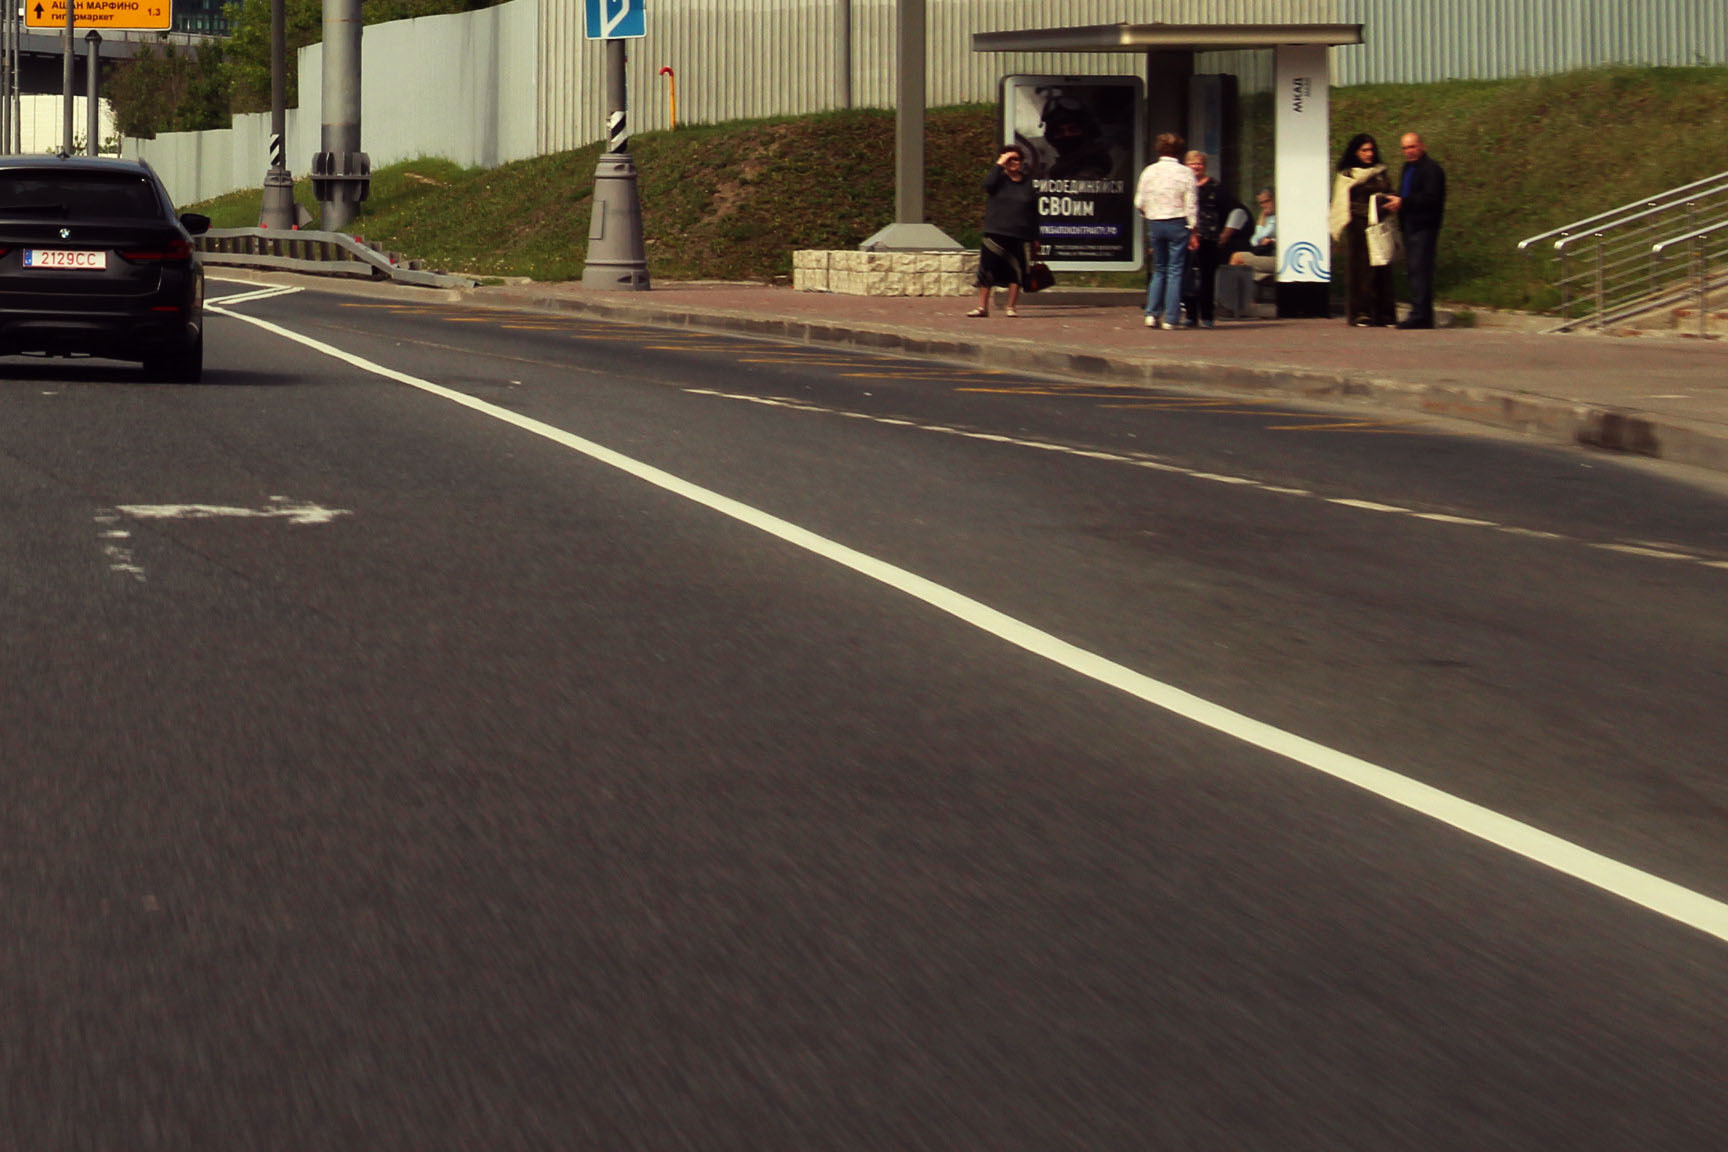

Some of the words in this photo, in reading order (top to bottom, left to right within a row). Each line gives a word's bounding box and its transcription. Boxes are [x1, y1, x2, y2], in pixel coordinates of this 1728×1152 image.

[86, 1, 139, 11] МАРФИНО
[147, 8, 161, 16] 1.3
[51, 14, 114, 22] гипрмаркет
[1033, 178, 1124, 194] РИСОЕДИНЯЙСЯ
[41, 252, 96, 266] 2129CC
